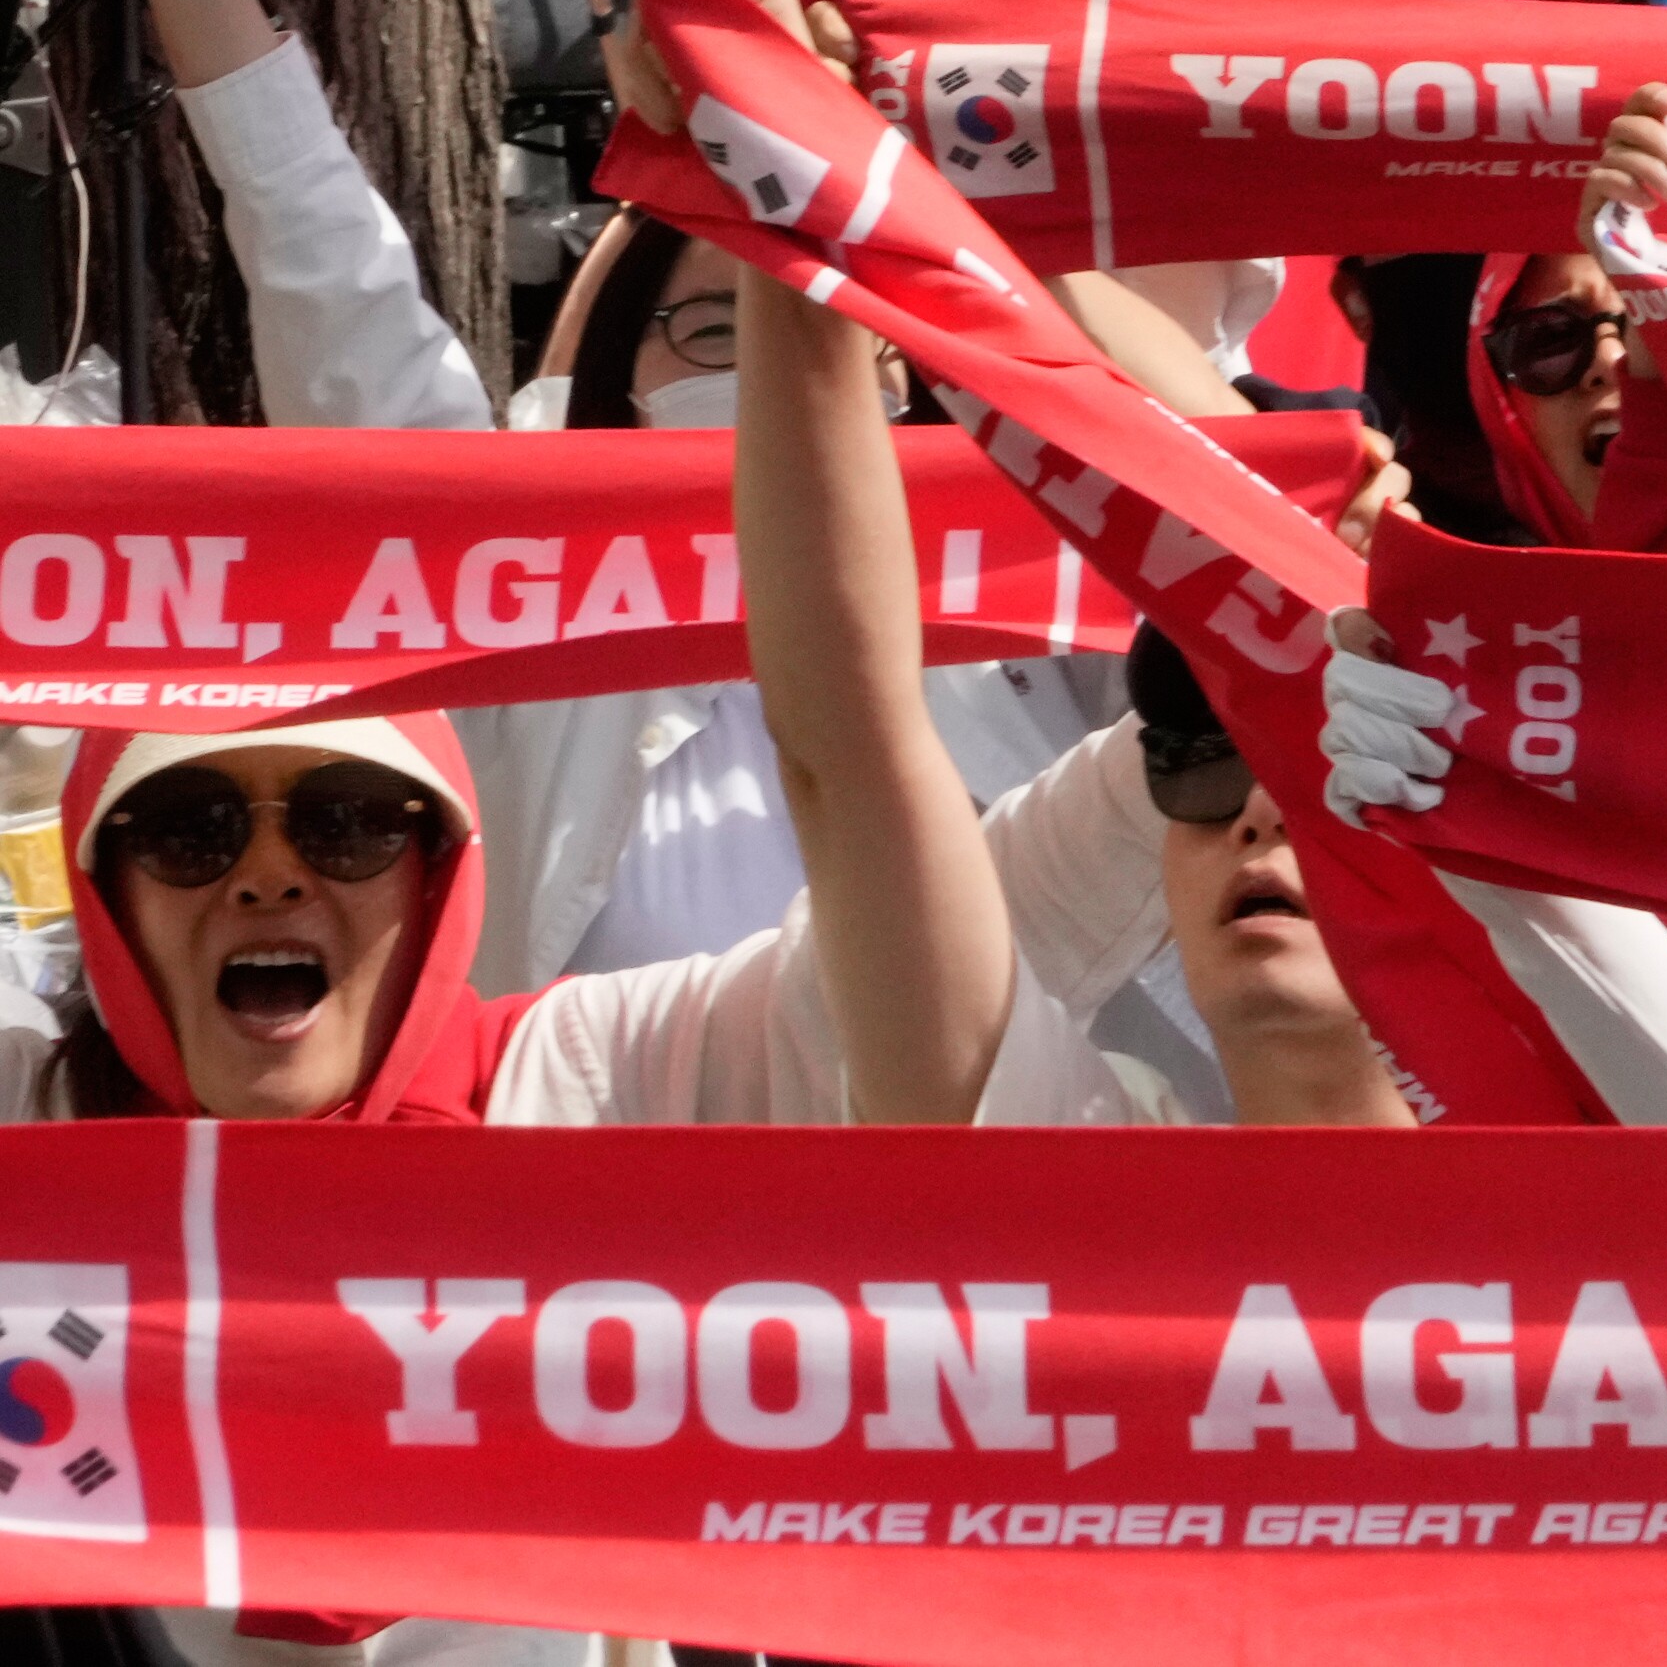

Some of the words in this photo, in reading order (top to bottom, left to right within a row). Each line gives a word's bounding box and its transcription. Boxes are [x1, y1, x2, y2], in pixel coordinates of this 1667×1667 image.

[1171, 54, 1597, 146] YOON
[1384, 160, 1520, 179] MAKE
[335, 1277, 1117, 1474] YOON,
[699, 1501, 930, 1546] MAKE
[947, 1501, 1224, 1548] KOREA
[1243, 1502, 1514, 1547] GREAT
